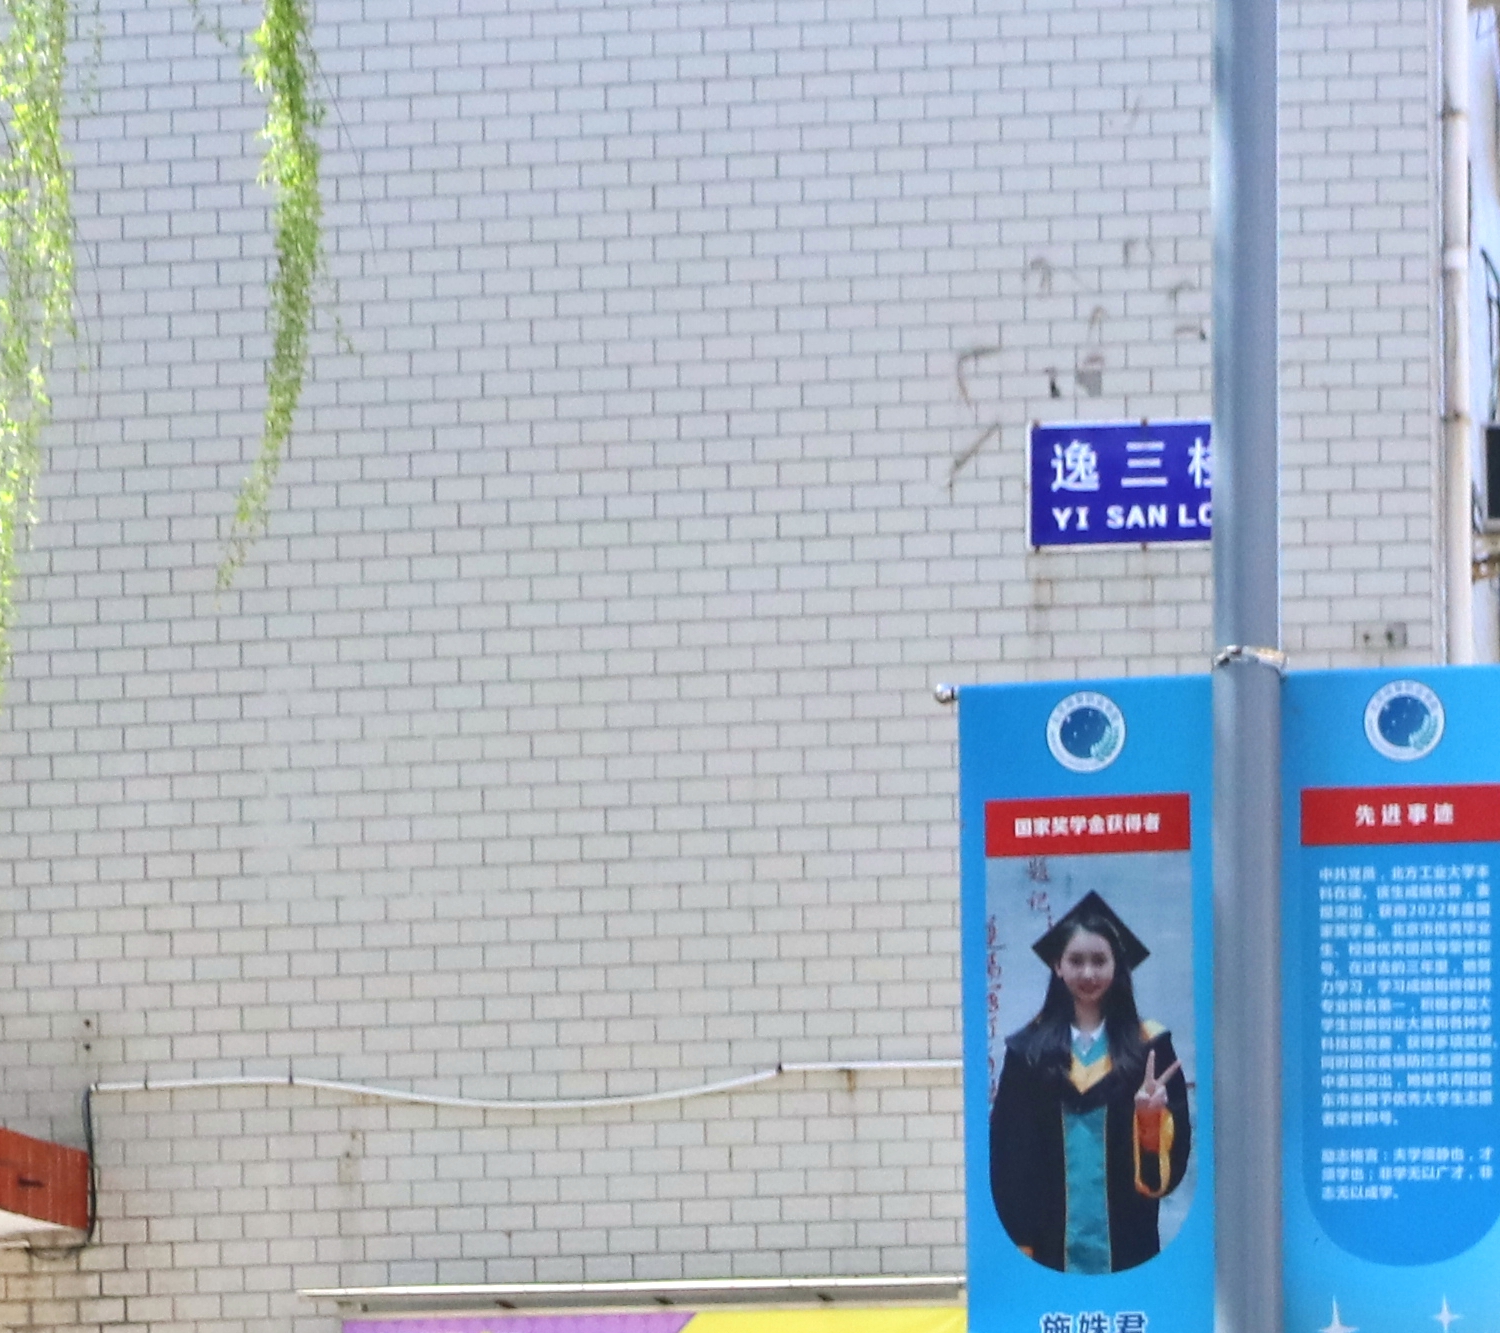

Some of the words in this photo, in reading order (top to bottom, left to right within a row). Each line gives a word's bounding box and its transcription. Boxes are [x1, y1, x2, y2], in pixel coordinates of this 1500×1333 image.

[1052, 505, 1090, 532] YI
[1106, 503, 1169, 530] SAN
[1013, 812, 1161, 839] 国家奖学金获得者
[1355, 802, 1454, 828] 先进事迹
